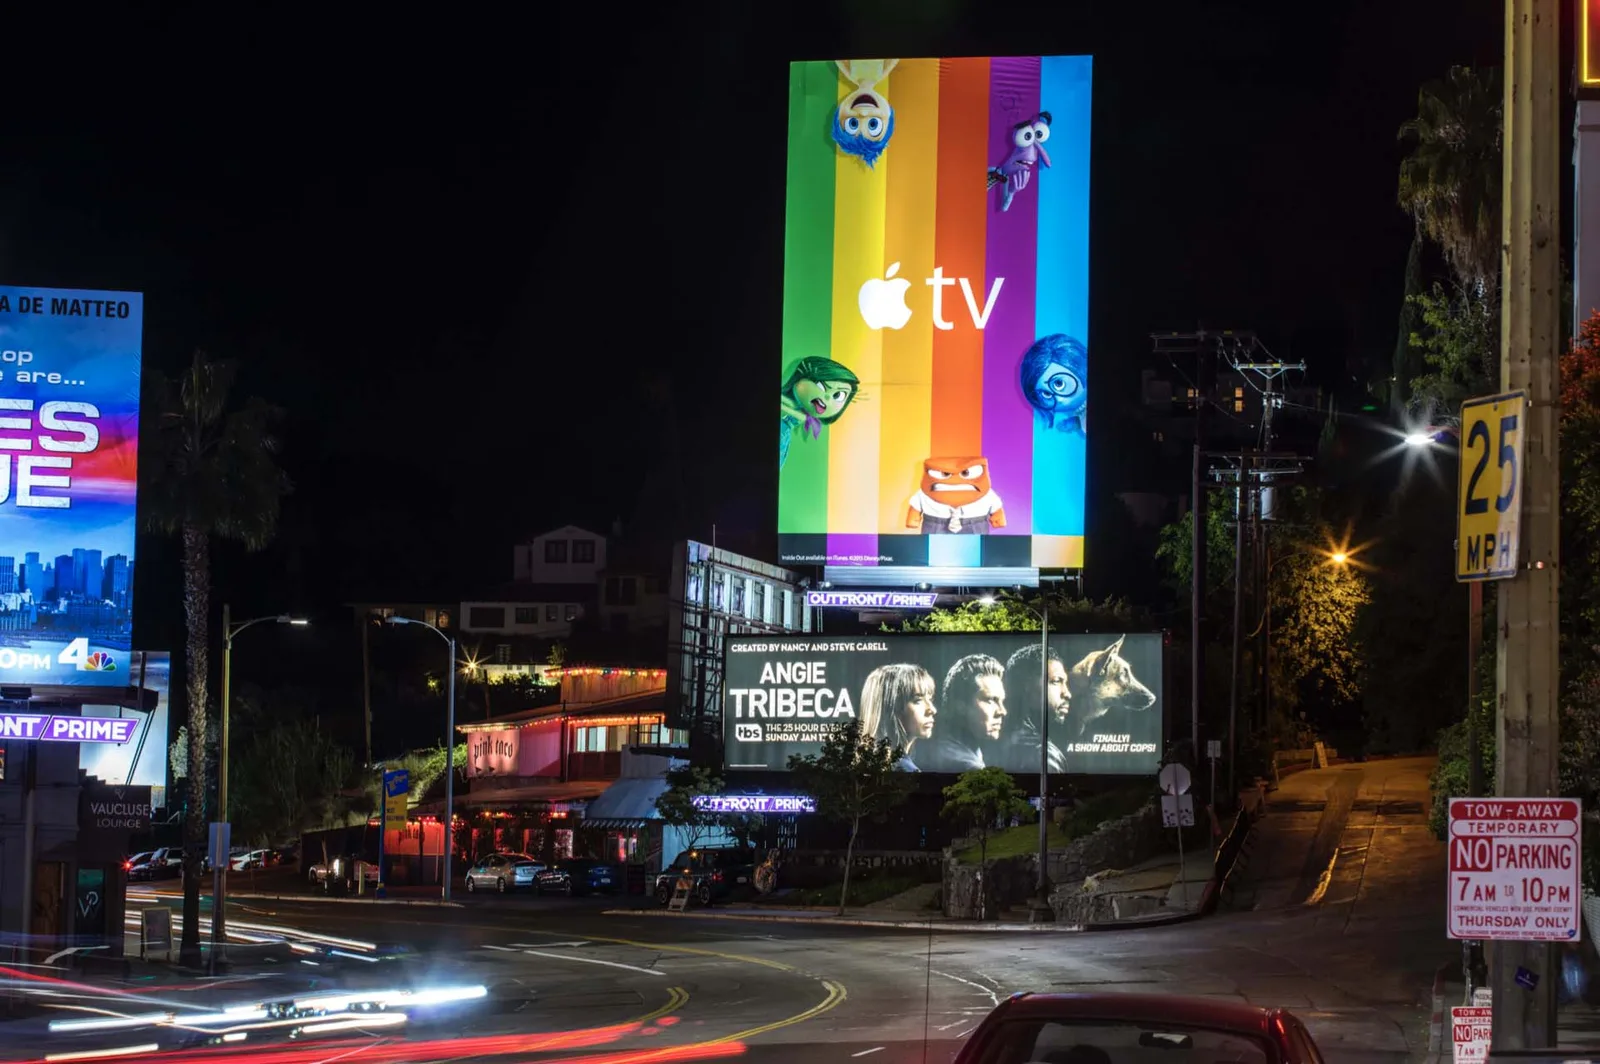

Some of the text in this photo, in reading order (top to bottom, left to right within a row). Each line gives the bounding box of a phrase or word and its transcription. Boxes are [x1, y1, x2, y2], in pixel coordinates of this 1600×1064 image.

[926, 266, 1005, 331] tv
[19, 297, 43, 314] DE
[51, 298, 130, 319] MATTEO
[0, 350, 33, 366] op
[17, 371, 85, 385] are...
[1465, 415, 1517, 515] 25
[0, 454, 73, 509] E
[1467, 532, 1510, 571] MPH
[810, 593, 932, 606] OUTFRONT PRIME
[58, 638, 89, 671] 4
[731, 642, 888, 652] CREATED BY NANCY AND STEVE CARELL
[759, 662, 826, 684] ANGIE
[729, 688, 856, 718] TRIBECA
[0, 716, 128, 740] NT PRIME
[737, 725, 761, 740] tbs
[765, 723, 782, 732] THE
[783, 723, 793, 732] 25
[795, 723, 819, 732] HOUR
[765, 733, 799, 742] SUNDAY
[800, 733, 817, 742] JAN
[1093, 734, 1130, 743] FINALLY!
[1067, 743, 1156, 753] A SHOW ABOUT COPS!
[90, 803, 149, 816] VAUCLUSE
[97, 819, 141, 829] LOUNGE
[1468, 823, 1559, 833] TEMPORARY
[1456, 839, 1571, 870] NO PARKING
[1458, 915, 1570, 928] THURSDAY ONLY
[1455, 1026, 1471, 1041] NO
